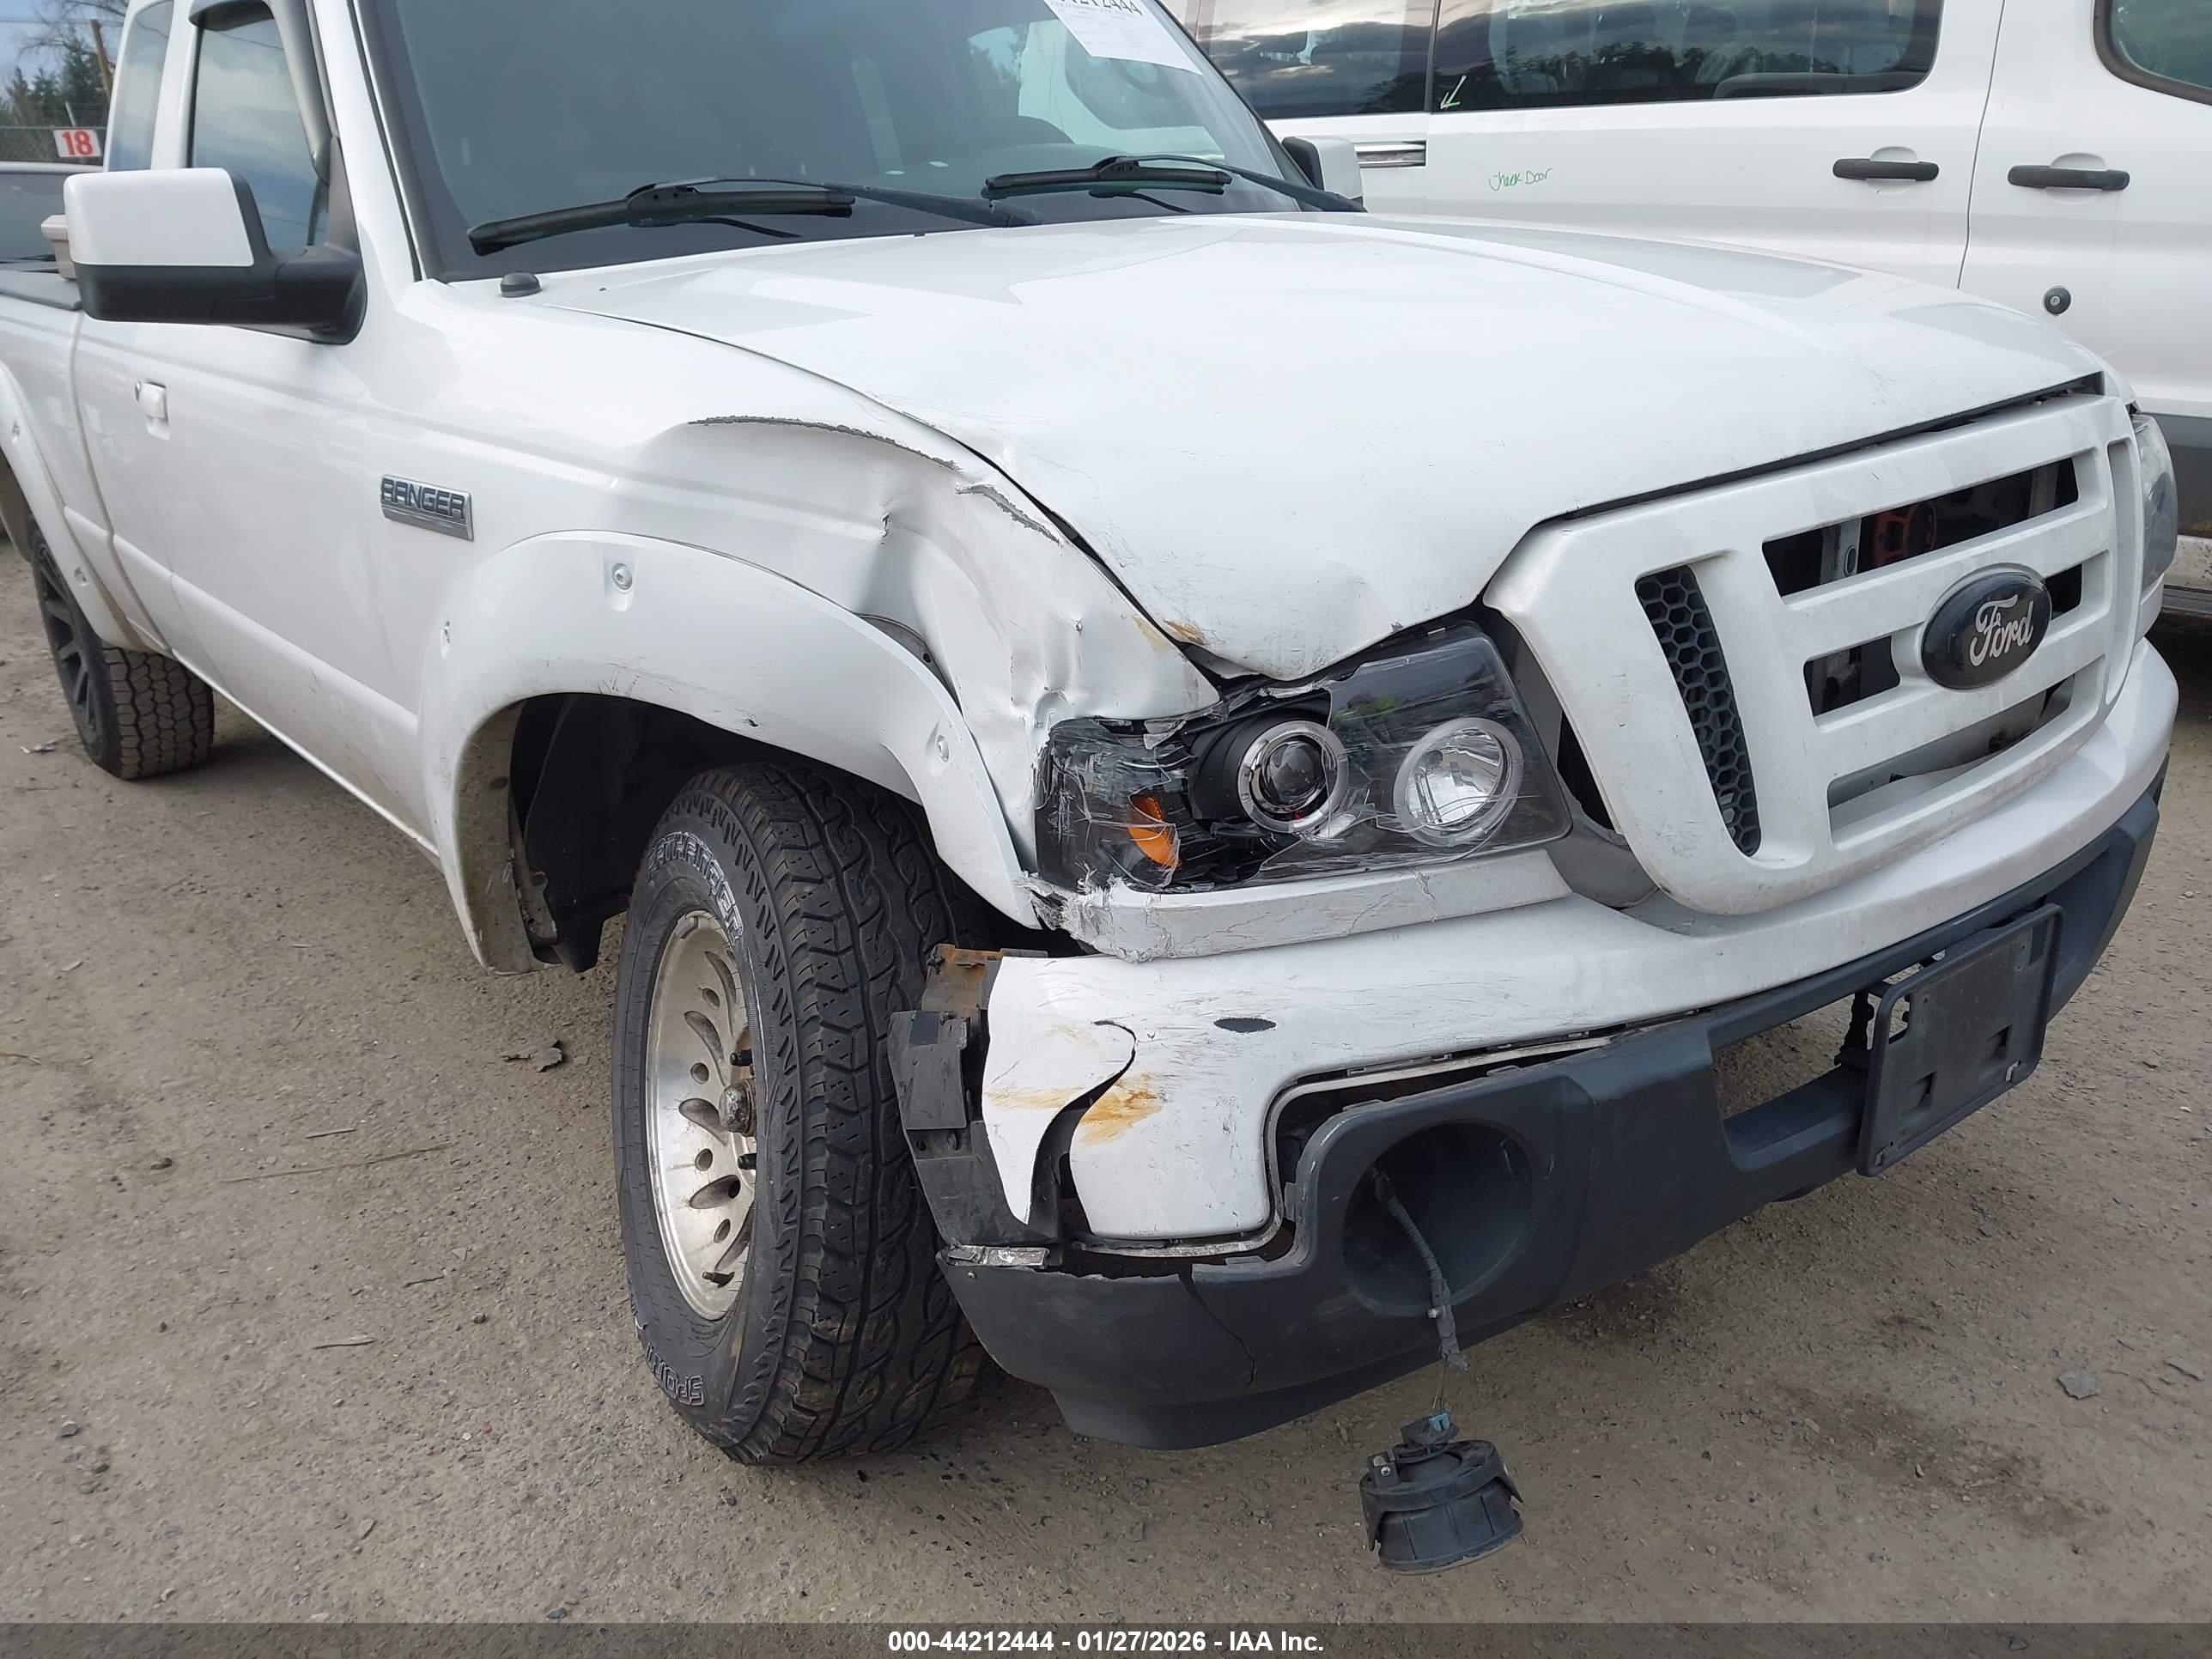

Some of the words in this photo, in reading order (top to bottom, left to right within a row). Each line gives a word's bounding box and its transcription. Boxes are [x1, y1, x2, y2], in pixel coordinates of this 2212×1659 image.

[62, 131, 93, 155] 18
[1524, 167, 1553, 185] Door
[380, 477, 466, 520] RANGER
[1969, 594, 2034, 666] Ford
